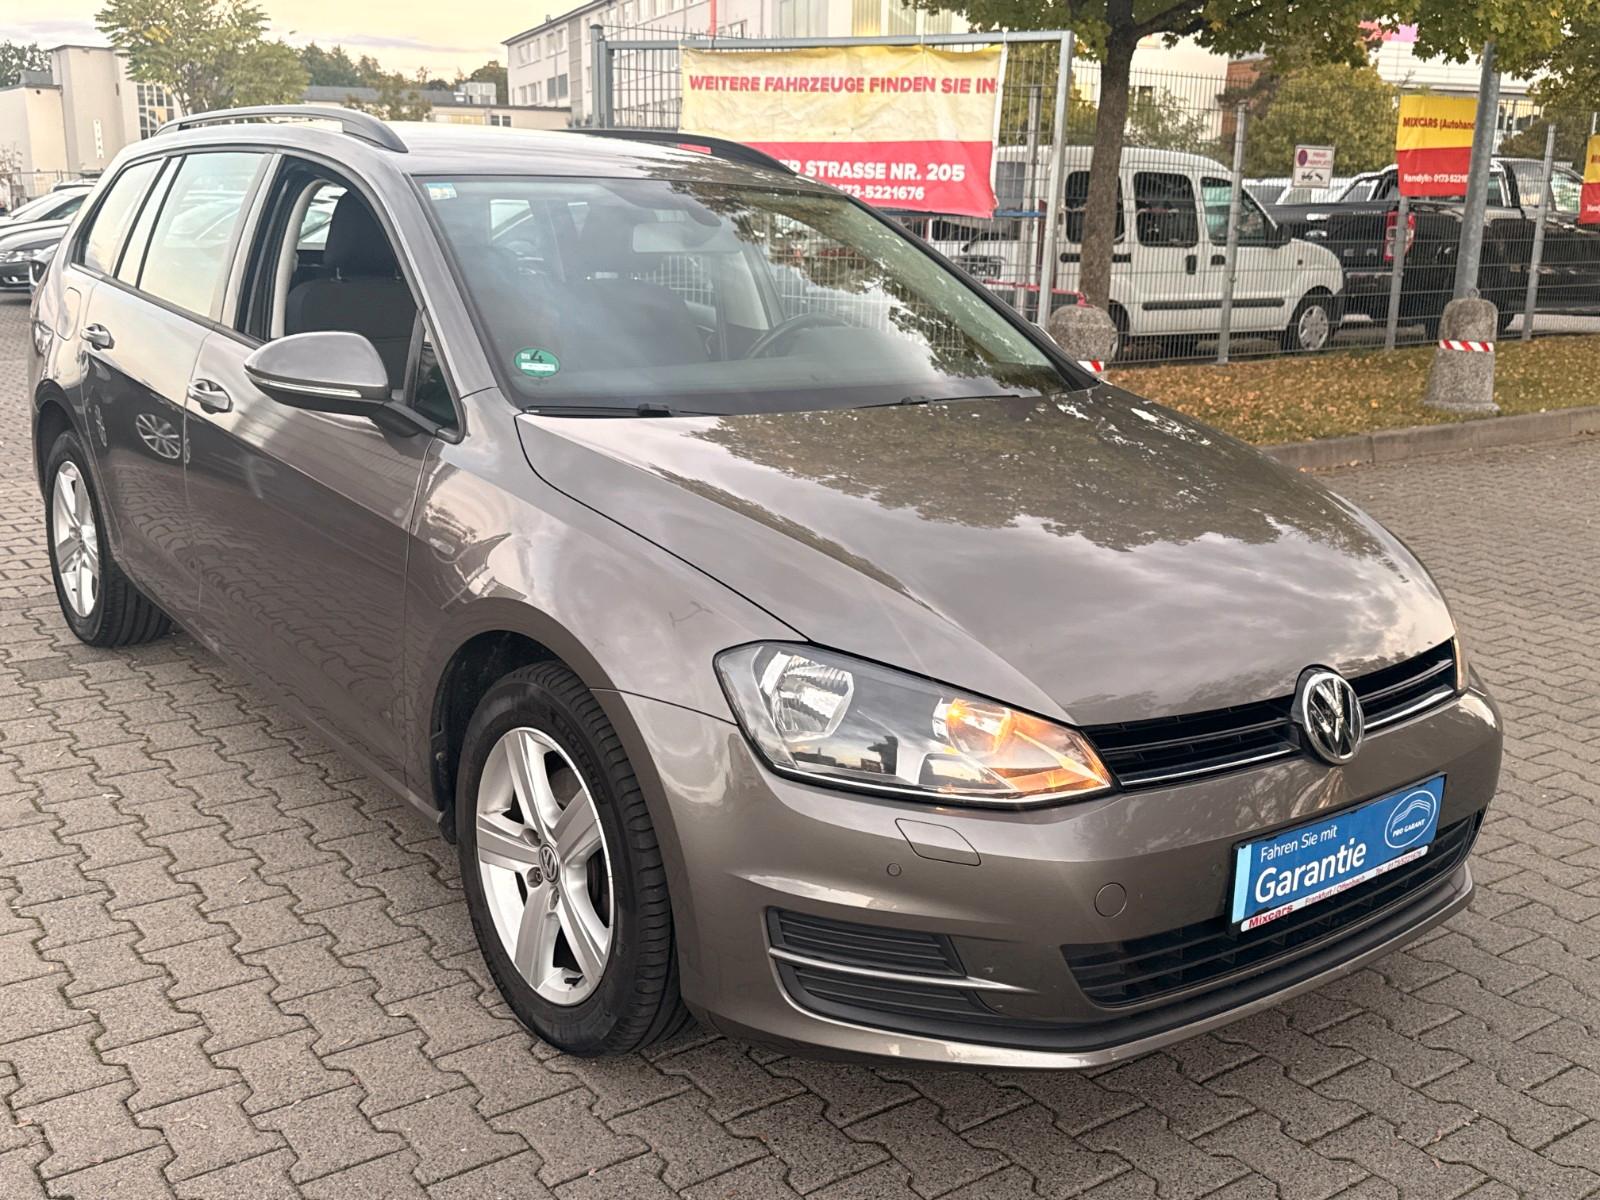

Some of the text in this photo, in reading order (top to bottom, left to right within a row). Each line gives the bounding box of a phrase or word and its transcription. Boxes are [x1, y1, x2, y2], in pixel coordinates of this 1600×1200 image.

[690, 75, 760, 92] WEITERE
[765, 76, 864, 93] FAHRZEUGE
[870, 76, 937, 93] FINDEN
[941, 78, 971, 94] SIE
[1403, 117, 1438, 128] MIXCARS
[804, 161, 887, 180] STRASSE
[889, 162, 922, 180] NR.
[926, 162, 966, 182] 205
[530, 350, 545, 364] 4
[1260, 824, 1338, 864] Fahren Sie mit
[1255, 837, 1367, 903] Garantie
[1248, 904, 1293, 929] Mixcars
